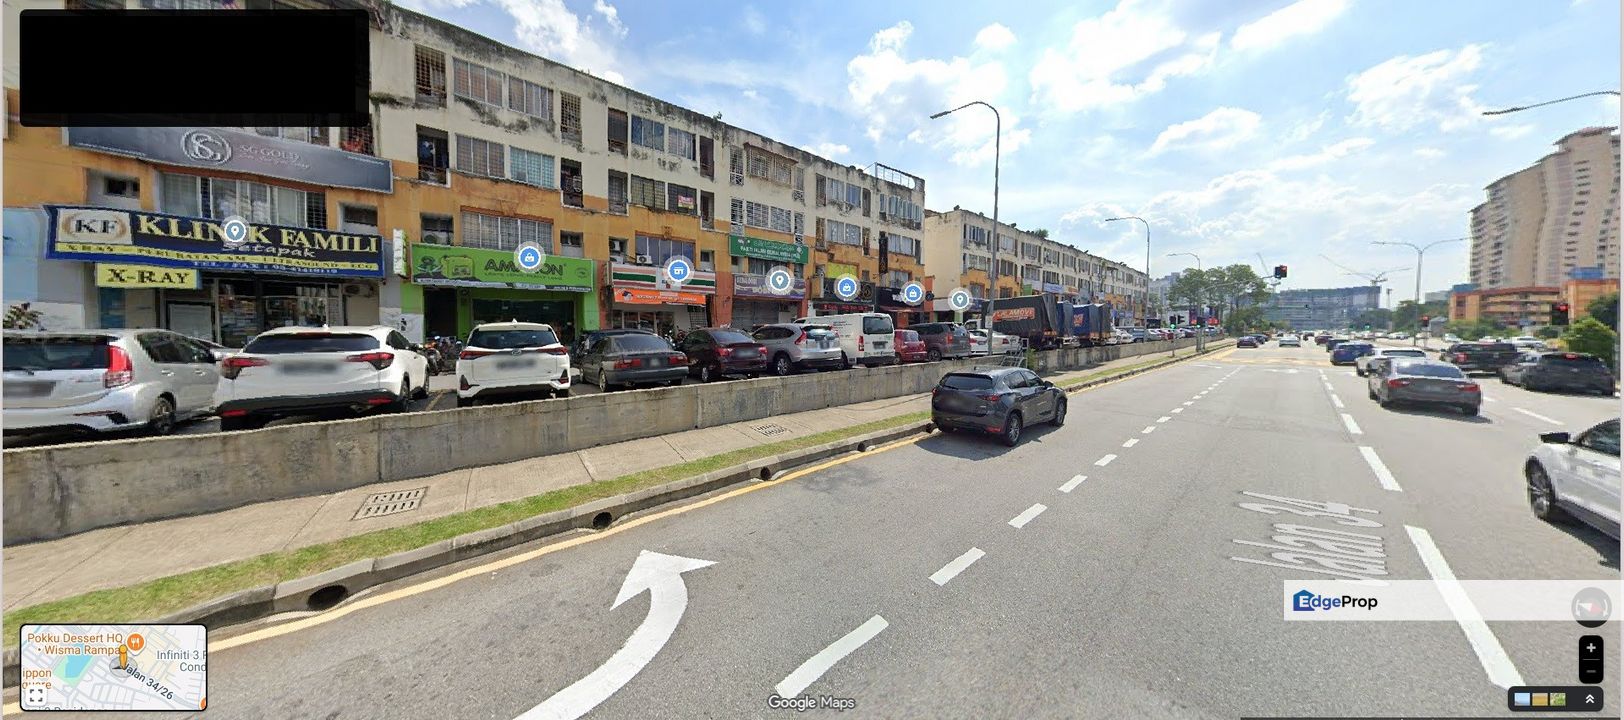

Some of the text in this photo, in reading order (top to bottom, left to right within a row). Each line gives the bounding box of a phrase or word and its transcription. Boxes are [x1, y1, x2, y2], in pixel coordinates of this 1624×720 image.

[75, 218, 117, 234] KF
[137, 215, 272, 244] KLINK
[280, 228, 378, 253] FAMILI
[223, 243, 317, 258] Setapak
[484, 259, 564, 276] AMON
[107, 268, 189, 284] X-RAY
